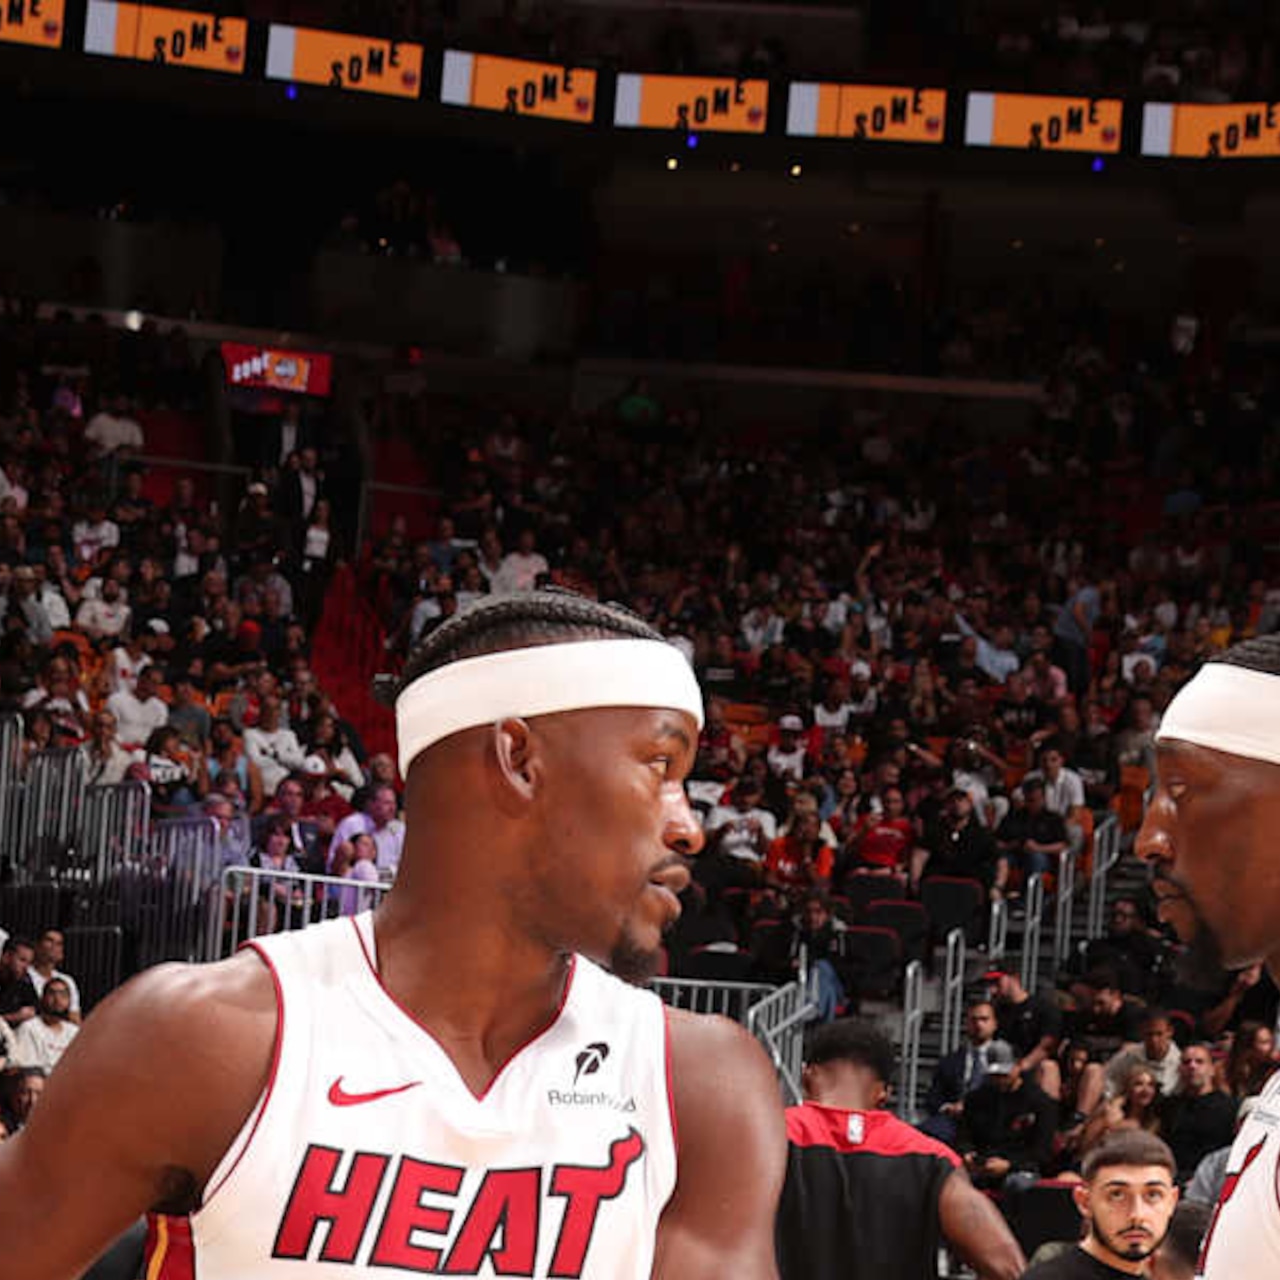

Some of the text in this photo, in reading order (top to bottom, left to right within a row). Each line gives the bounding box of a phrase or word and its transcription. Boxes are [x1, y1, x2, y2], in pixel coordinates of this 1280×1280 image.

[154, 15, 223, 63] SOME
[329, 41, 400, 87] SOME
[505, 67, 572, 114] SOME
[677, 81, 745, 129] SOME
[854, 90, 922, 138] SOME
[1029, 99, 1098, 150] SOME
[1207, 102, 1277, 157] SOME
[271, 1126, 644, 1280] HEAT
